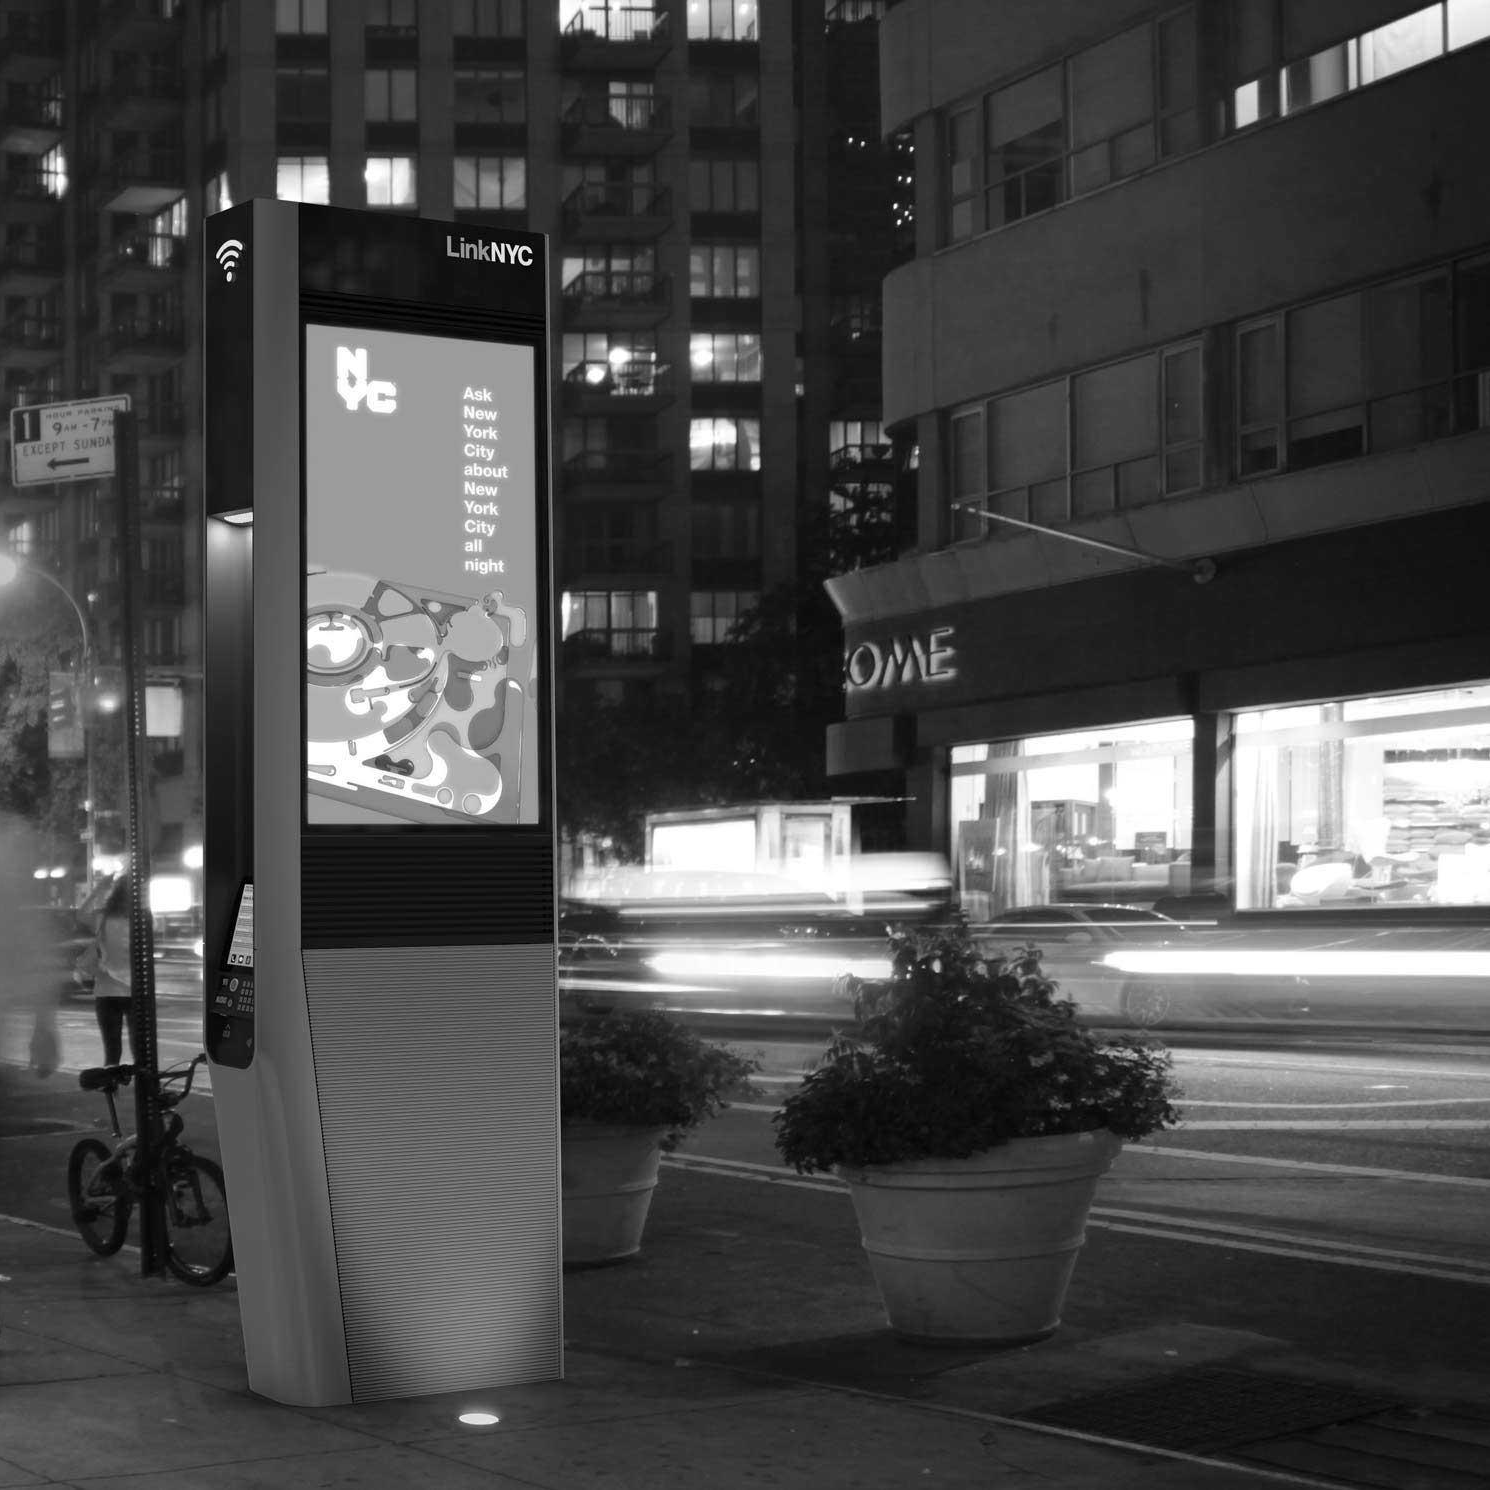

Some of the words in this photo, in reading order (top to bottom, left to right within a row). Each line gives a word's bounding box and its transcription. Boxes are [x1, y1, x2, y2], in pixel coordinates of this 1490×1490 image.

[446, 235, 533, 267] LinkNYC
[463, 386, 493, 402] Ask
[463, 405, 498, 421] New
[22, 411, 30, 440] 1
[463, 423, 499, 441] York
[22, 441, 66, 457] EXCEPT
[73, 436, 115, 451] SUNDA
[463, 443, 495, 461] City
[463, 463, 509, 479] about
[464, 481, 498, 497] New
[464, 499, 499, 516] York
[464, 519, 496, 537] City
[464, 538, 483, 553] all
[464, 557, 505, 575] night
[842, 626, 958, 690] OME
